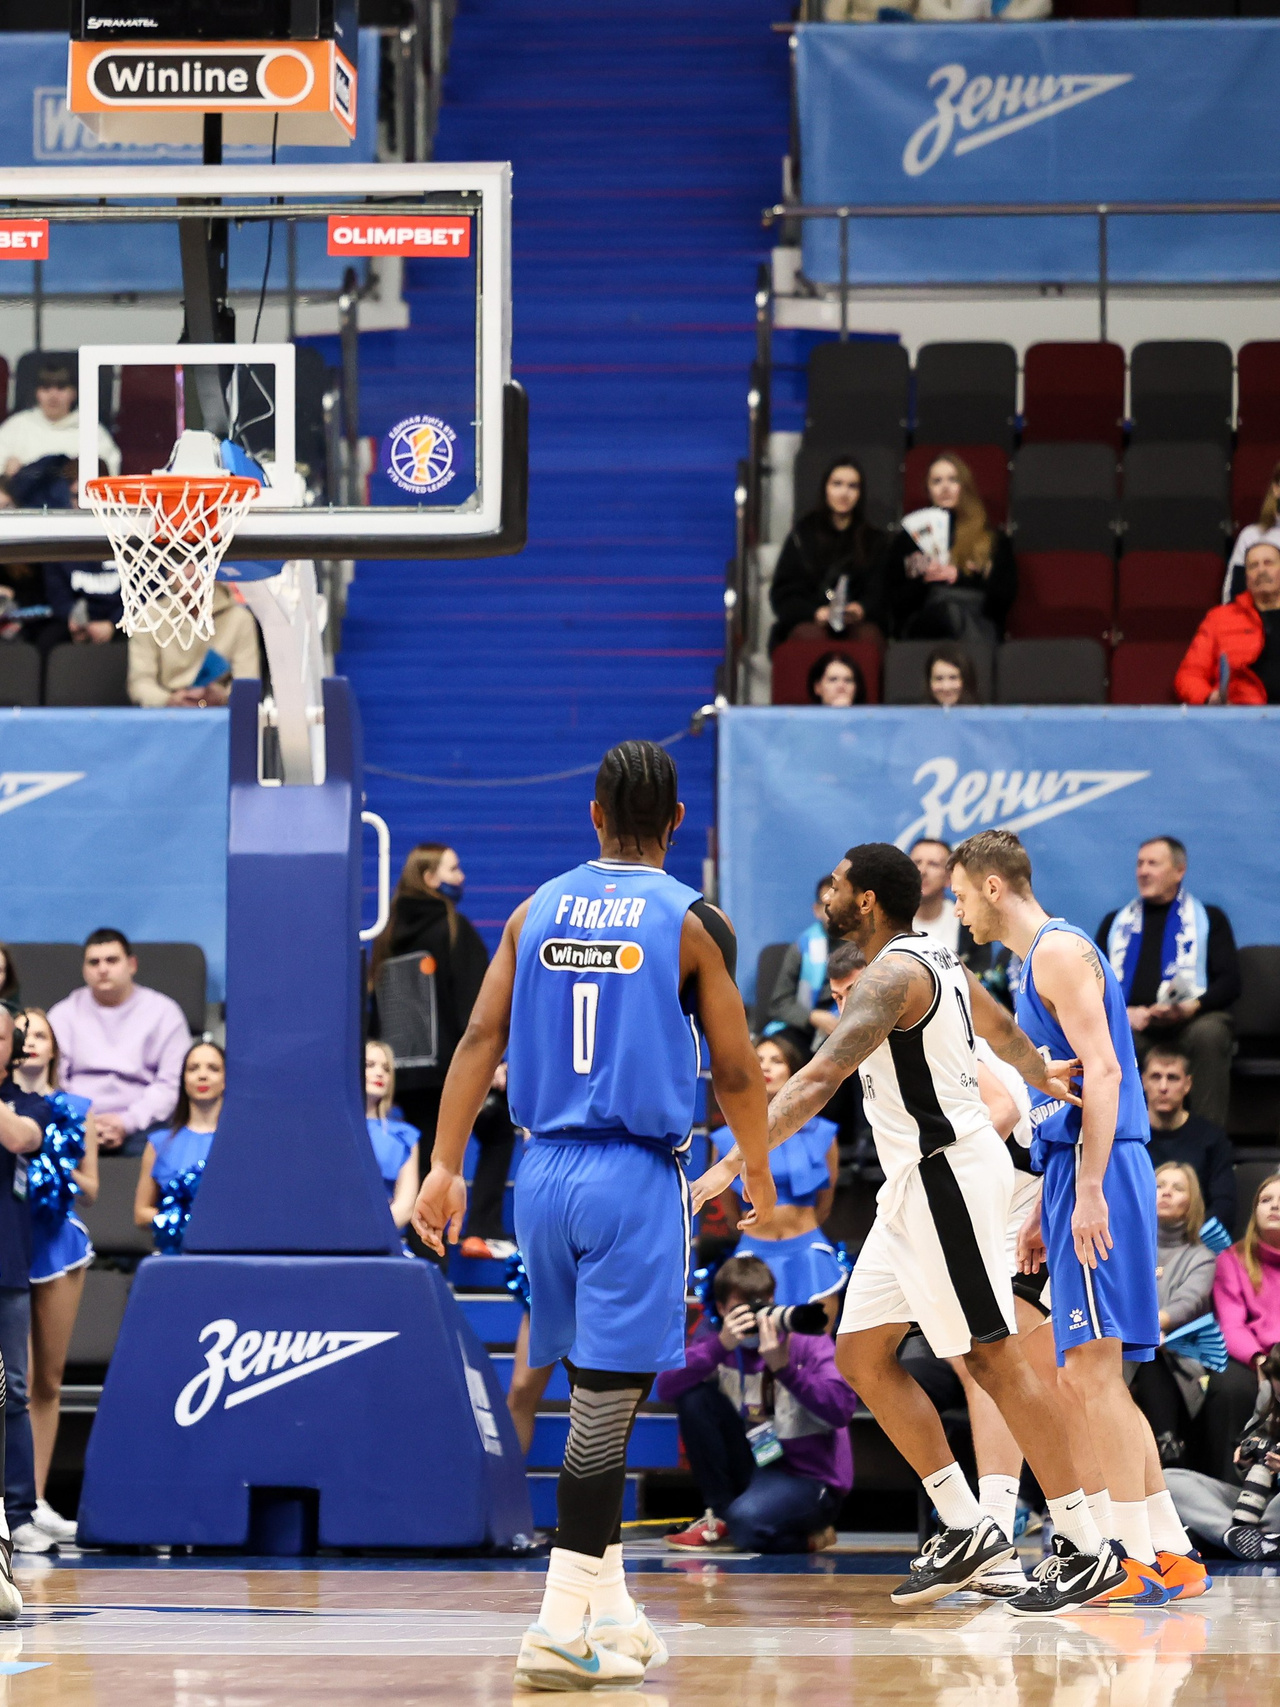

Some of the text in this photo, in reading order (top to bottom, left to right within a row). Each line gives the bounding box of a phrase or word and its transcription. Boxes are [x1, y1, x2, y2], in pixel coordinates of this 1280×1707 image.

[107, 61, 249, 93] Winline
[333, 226, 465, 246] OLIMPBET
[555, 894, 647, 930] FRAZIER
[551, 944, 613, 966] Winline
[572, 982, 600, 1075] 0
